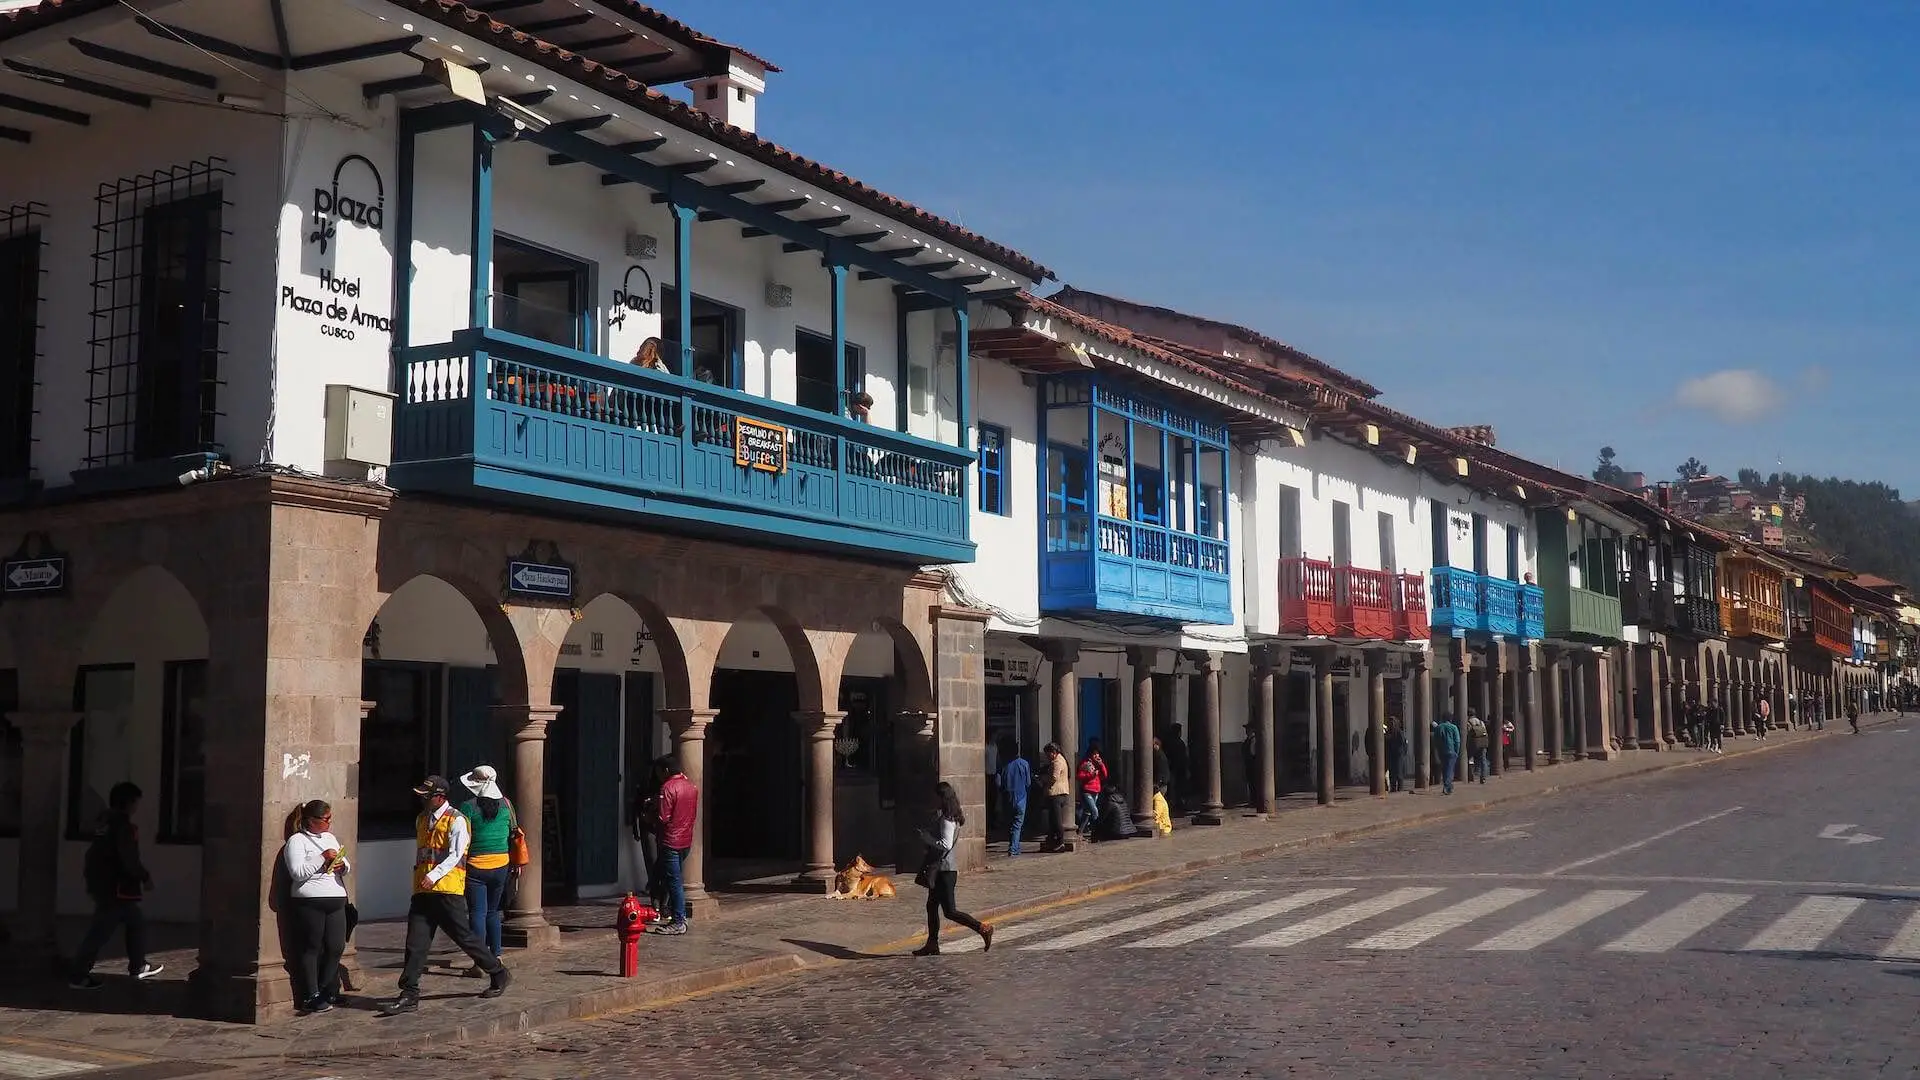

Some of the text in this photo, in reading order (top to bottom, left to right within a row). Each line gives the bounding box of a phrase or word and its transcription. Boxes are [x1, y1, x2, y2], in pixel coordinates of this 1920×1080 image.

[314, 181, 384, 229] plaza
[320, 268, 360, 299] Hotel
[282, 286, 323, 317] Plaza
[326, 297, 348, 321] de
[613, 284, 653, 314] plaza
[321, 324, 356, 341] CUSCO
[743, 445, 775, 465] Buffet
[748, 437, 783, 452] BREAKFAST
